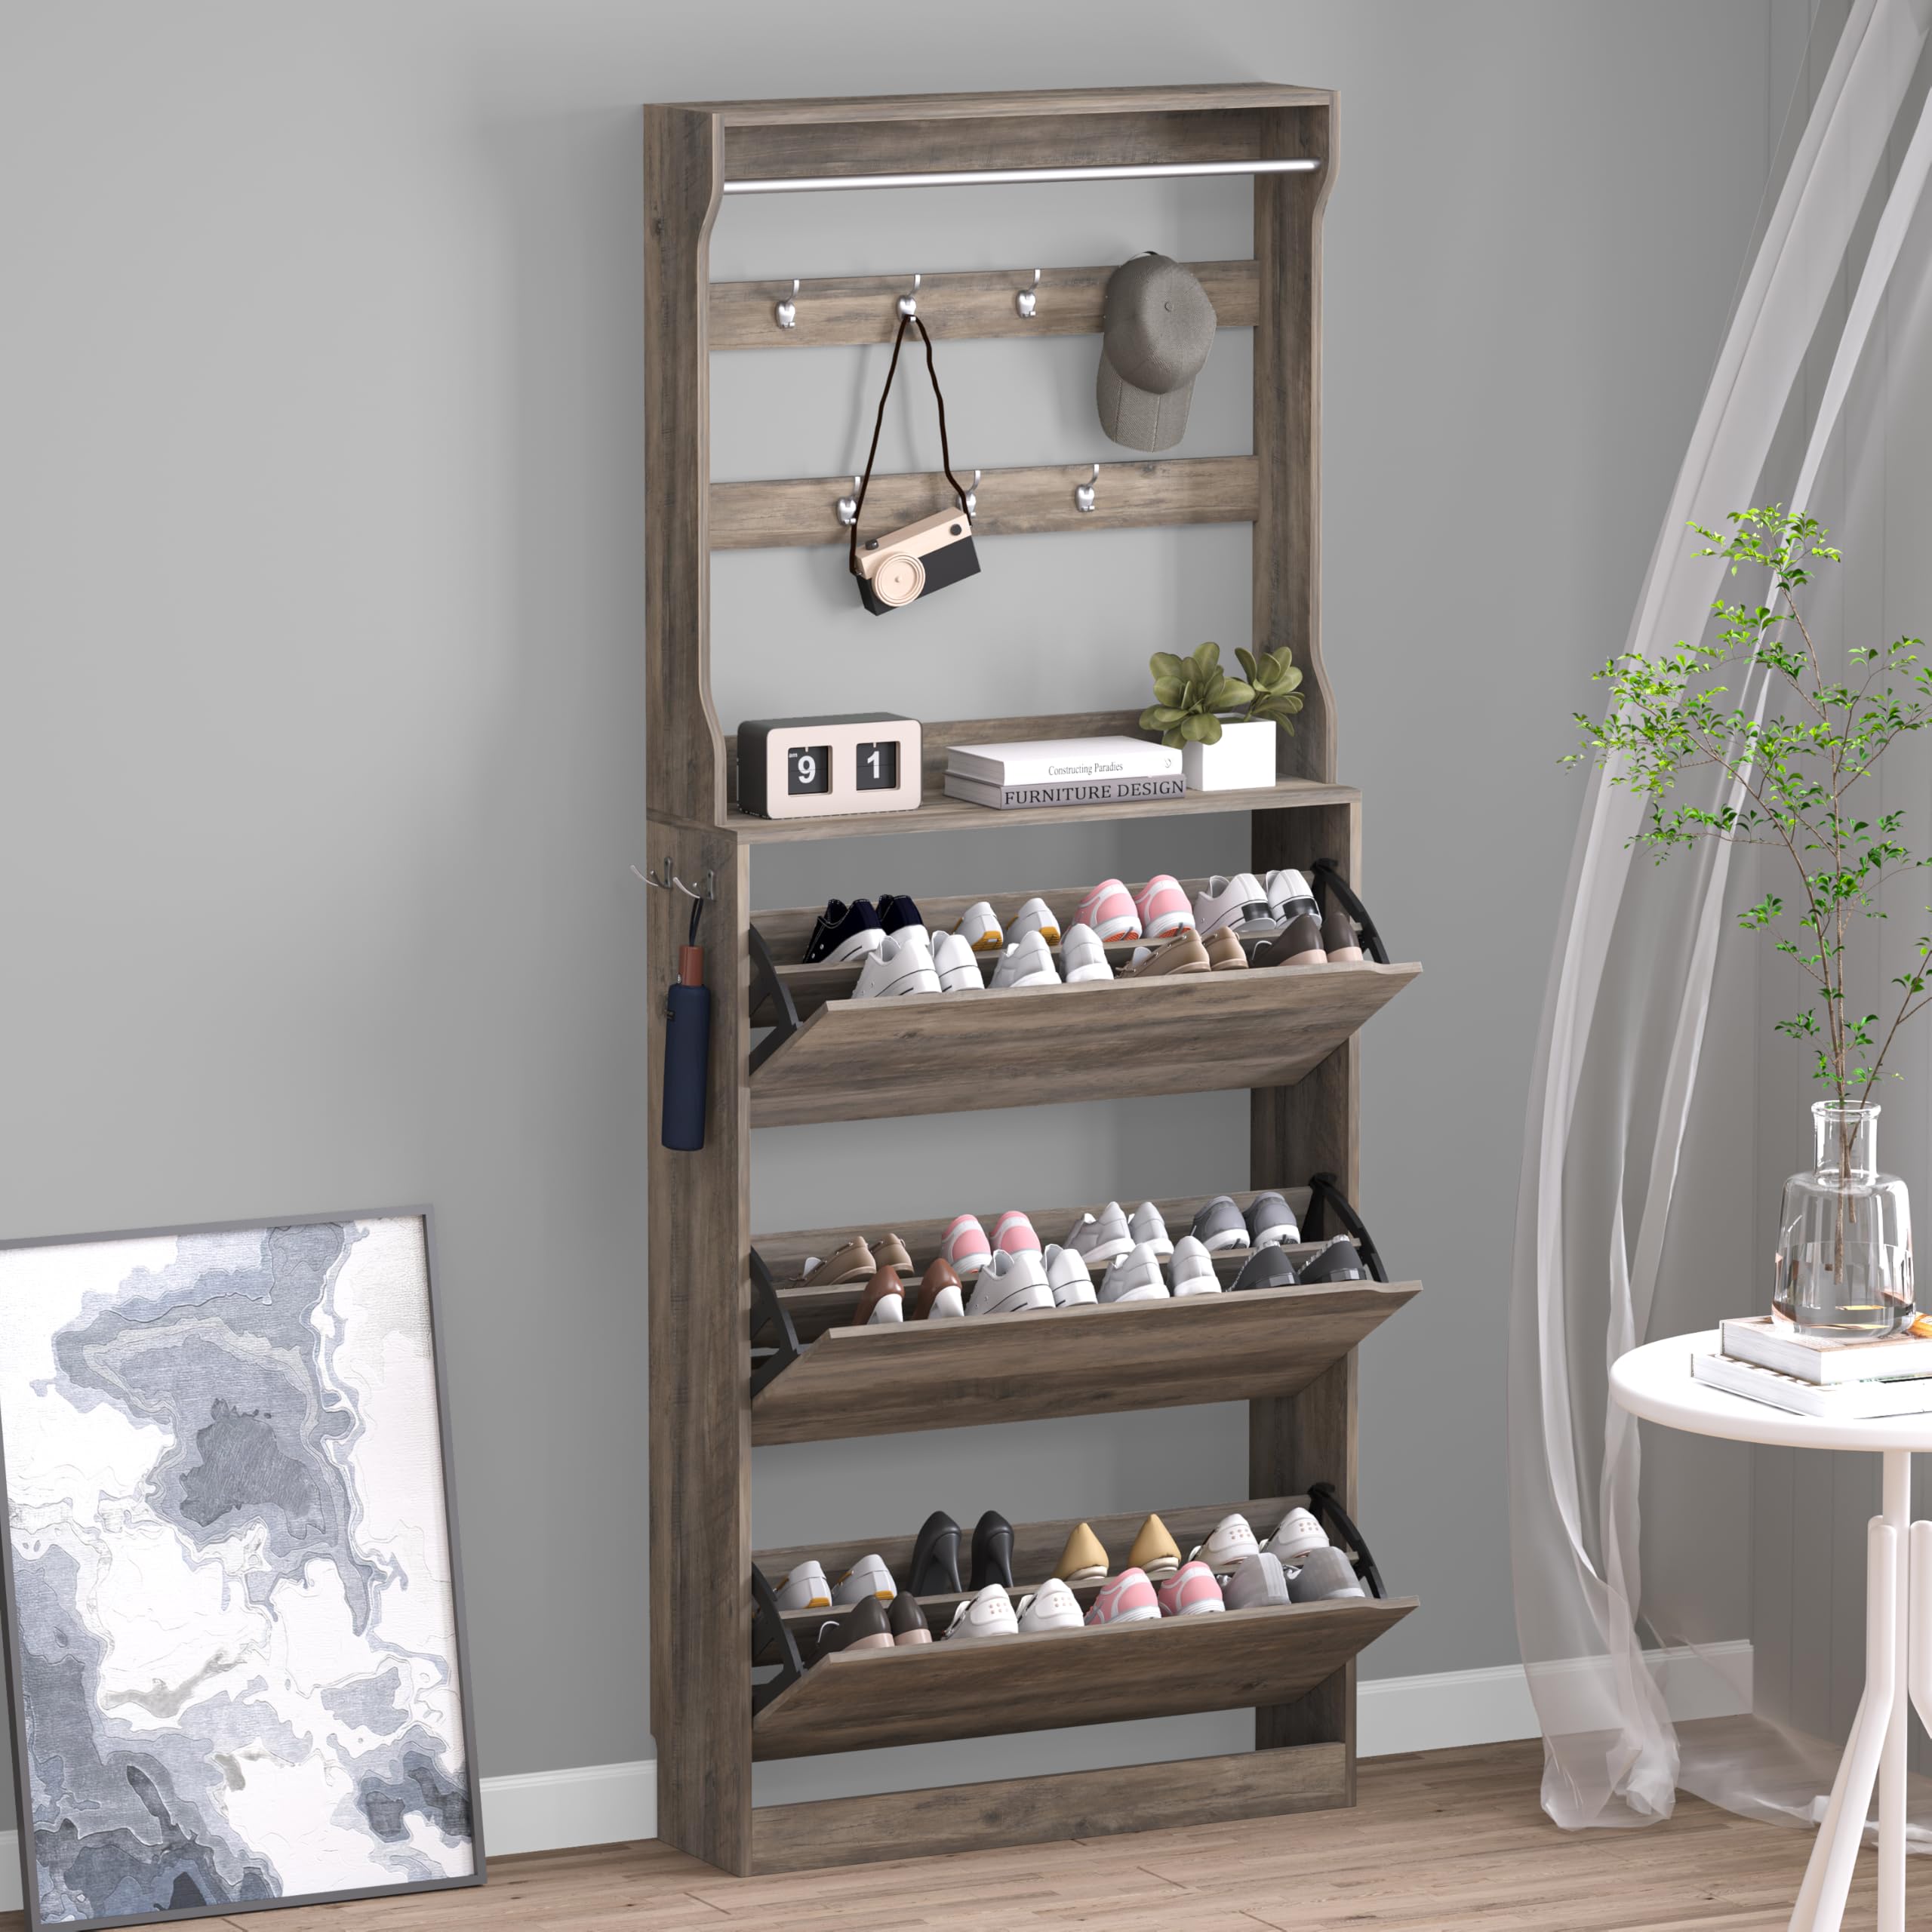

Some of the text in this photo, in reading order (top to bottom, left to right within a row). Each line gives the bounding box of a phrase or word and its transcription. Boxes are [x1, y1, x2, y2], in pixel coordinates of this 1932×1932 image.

[798, 751, 880, 783] 9 1
[1048, 761, 1123, 776] Constructing Paradies
[1004, 780, 1184, 804] FURNITURE DESIGN
